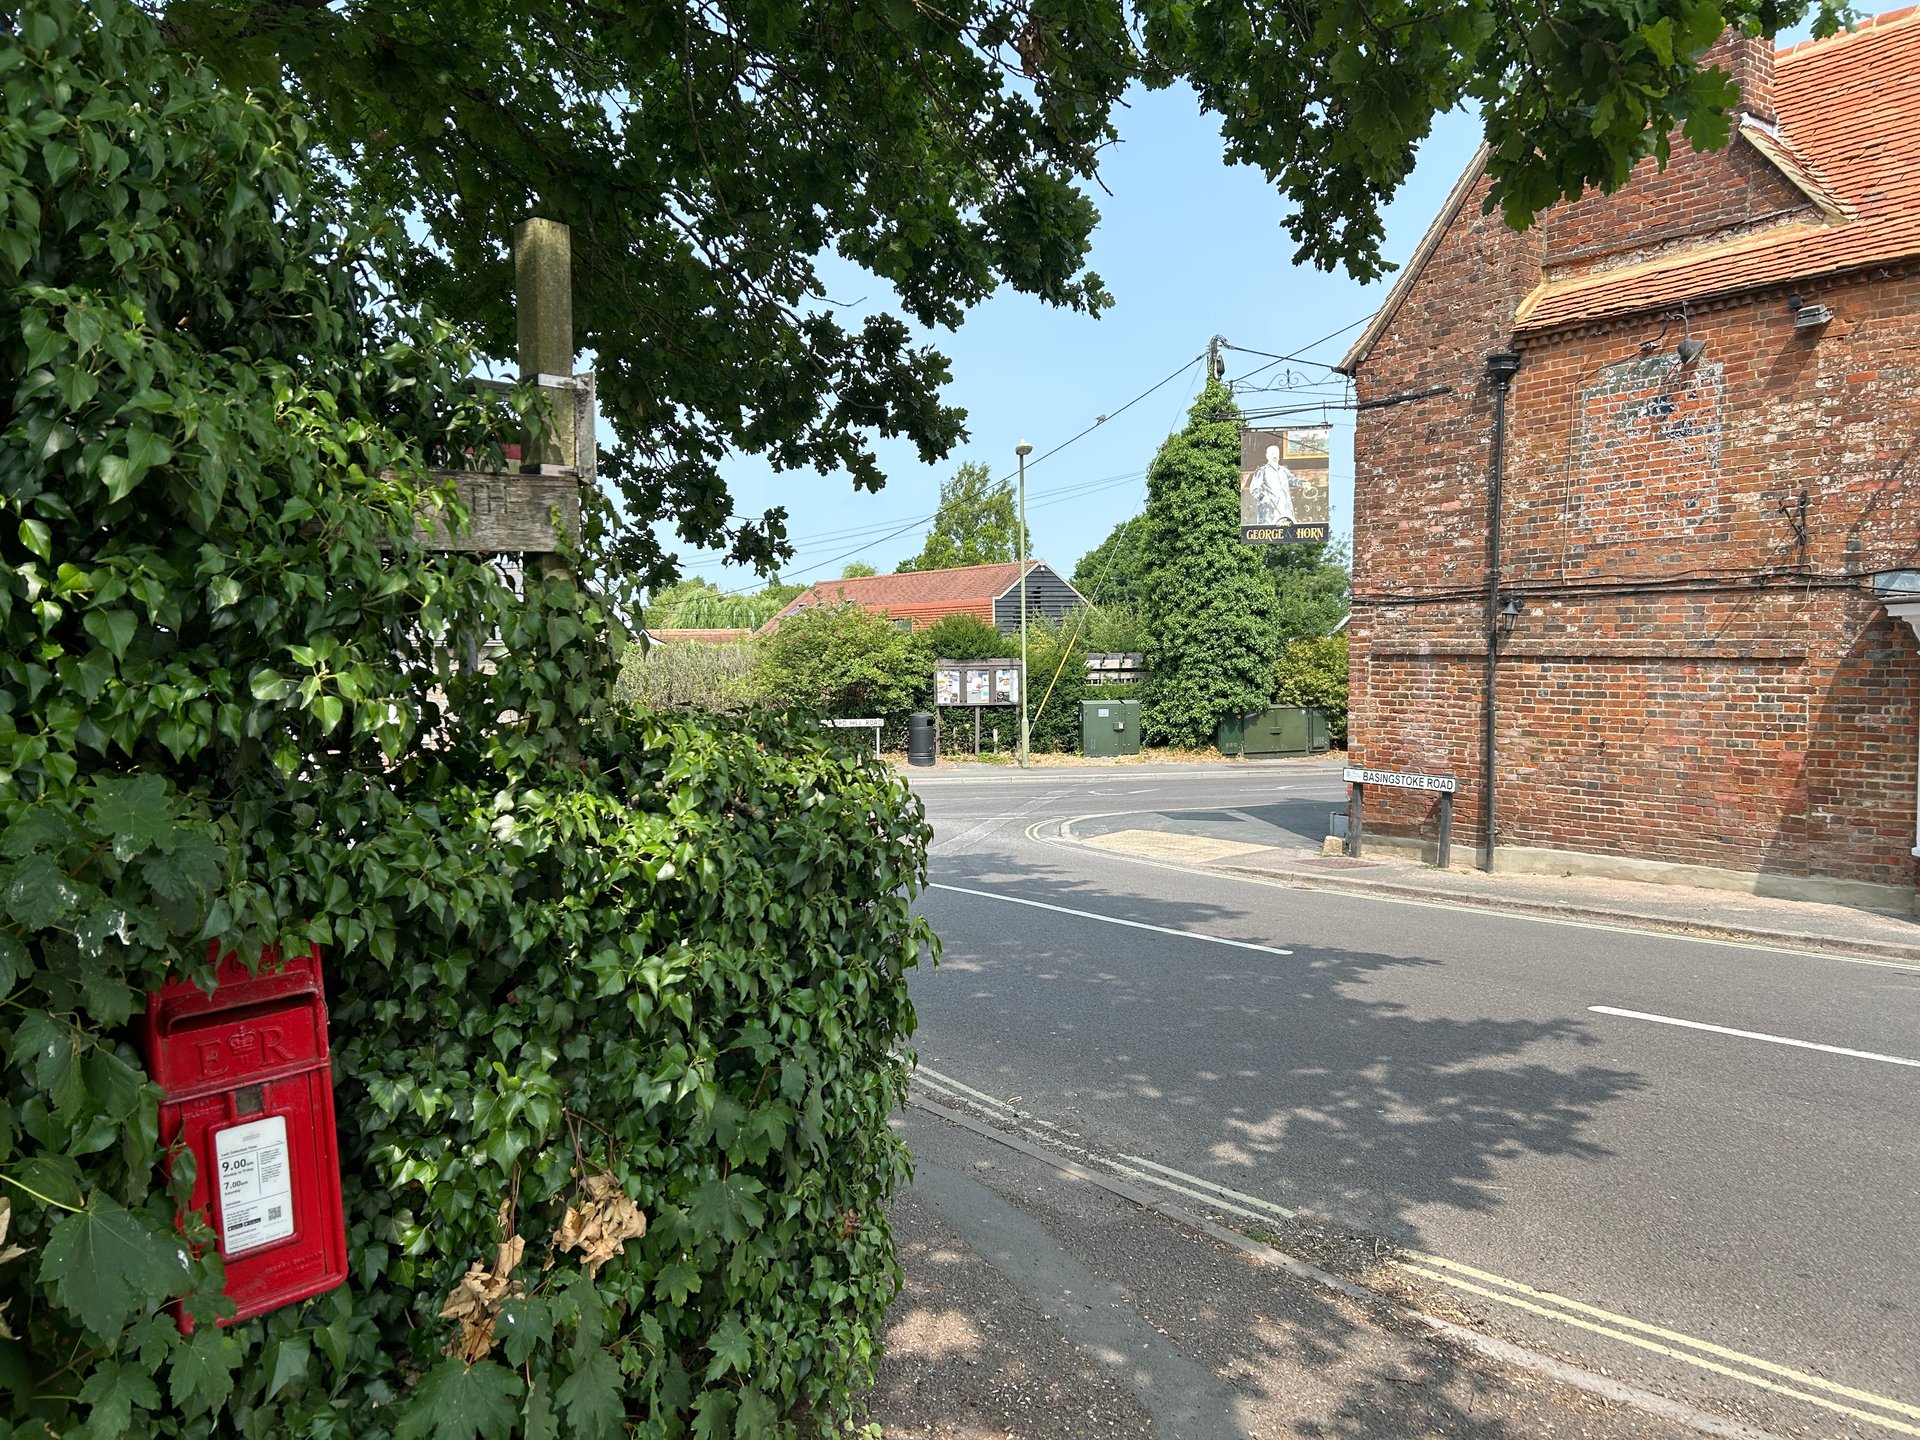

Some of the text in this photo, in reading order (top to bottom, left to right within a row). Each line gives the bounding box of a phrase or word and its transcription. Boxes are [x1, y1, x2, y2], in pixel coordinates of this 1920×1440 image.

[1246, 529, 1284, 542] GEORGE
[1296, 527, 1324, 541] HORN
[1362, 771, 1425, 787] BASINGSTOKE
[1426, 778, 1454, 790] ROAD
[194, 1038, 229, 1081] E
[258, 1025, 296, 1066] R
